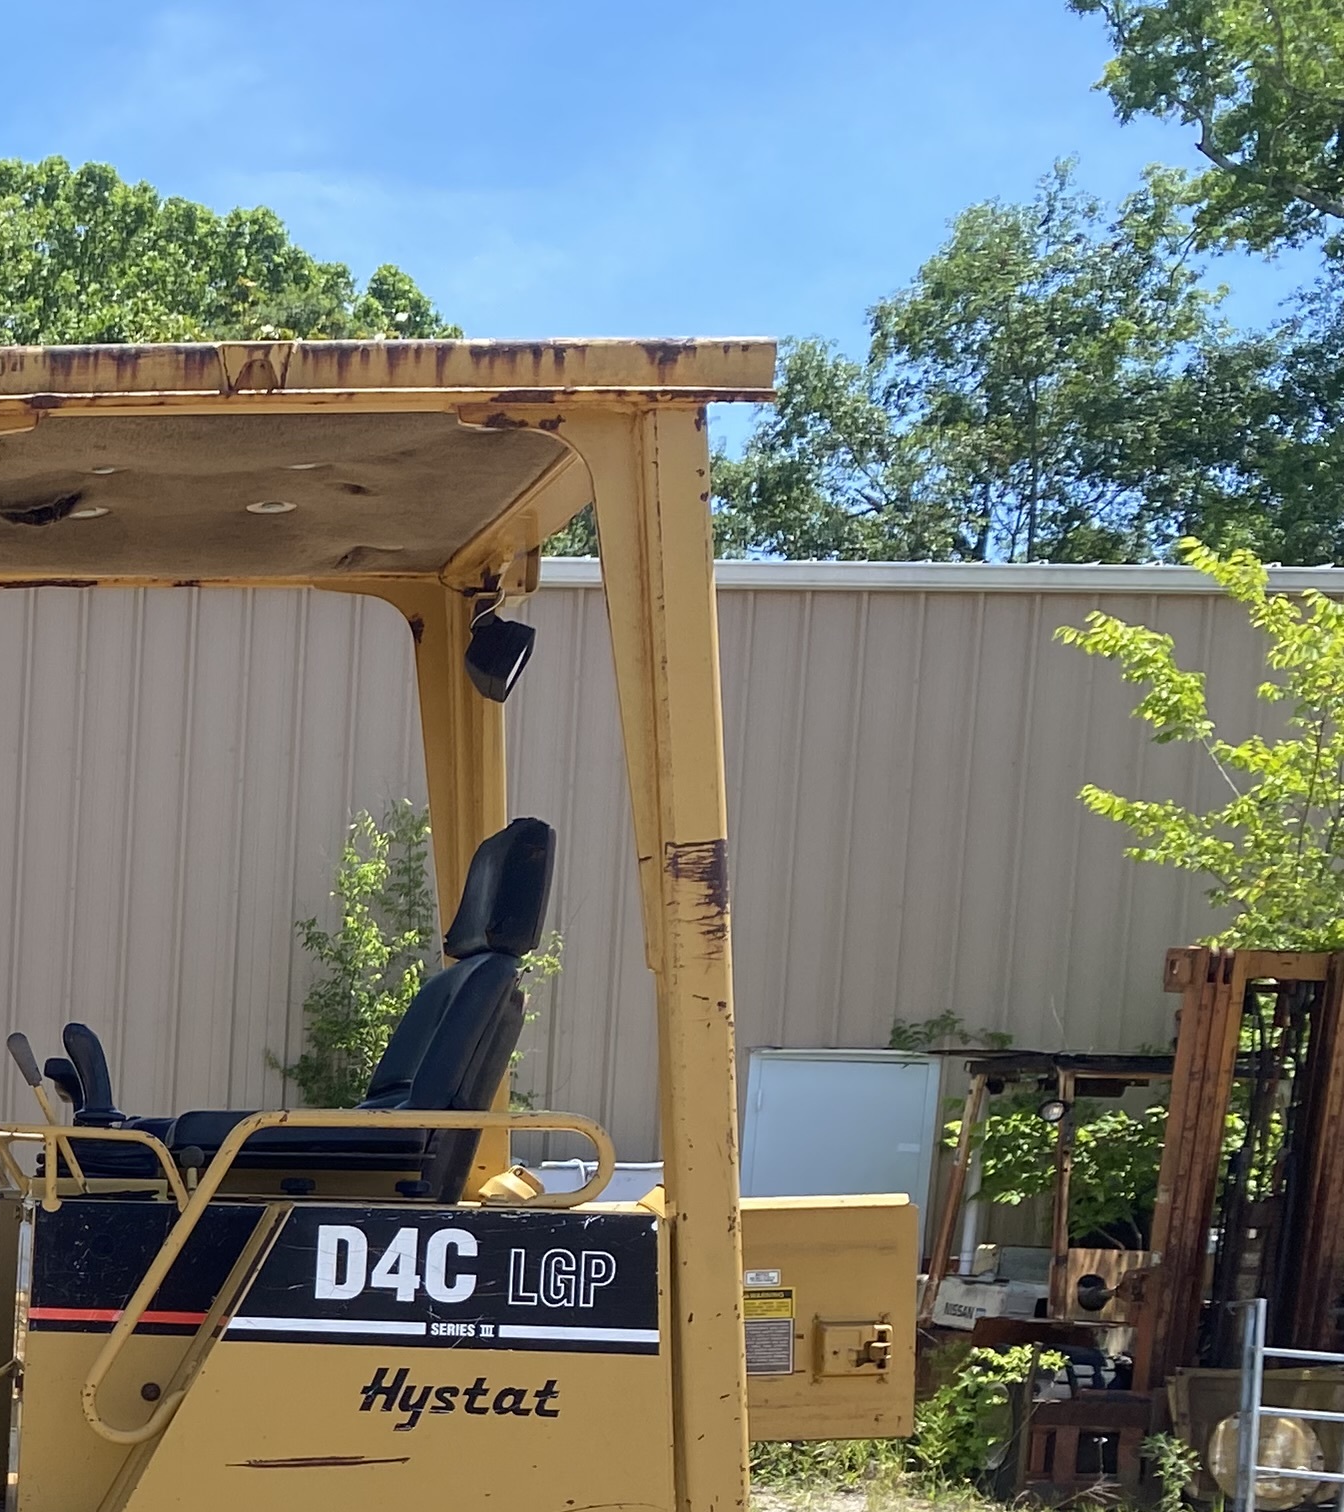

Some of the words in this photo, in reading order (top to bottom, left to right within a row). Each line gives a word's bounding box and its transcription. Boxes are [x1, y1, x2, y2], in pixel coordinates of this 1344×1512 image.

[315, 1225, 478, 1302] D4C
[507, 1248, 616, 1308] LGP
[430, 1322, 476, 1337] SERIES
[479, 1324, 495, 1338] III
[944, 1301, 976, 1320] NISSAN
[358, 1367, 561, 1432] Hystat
